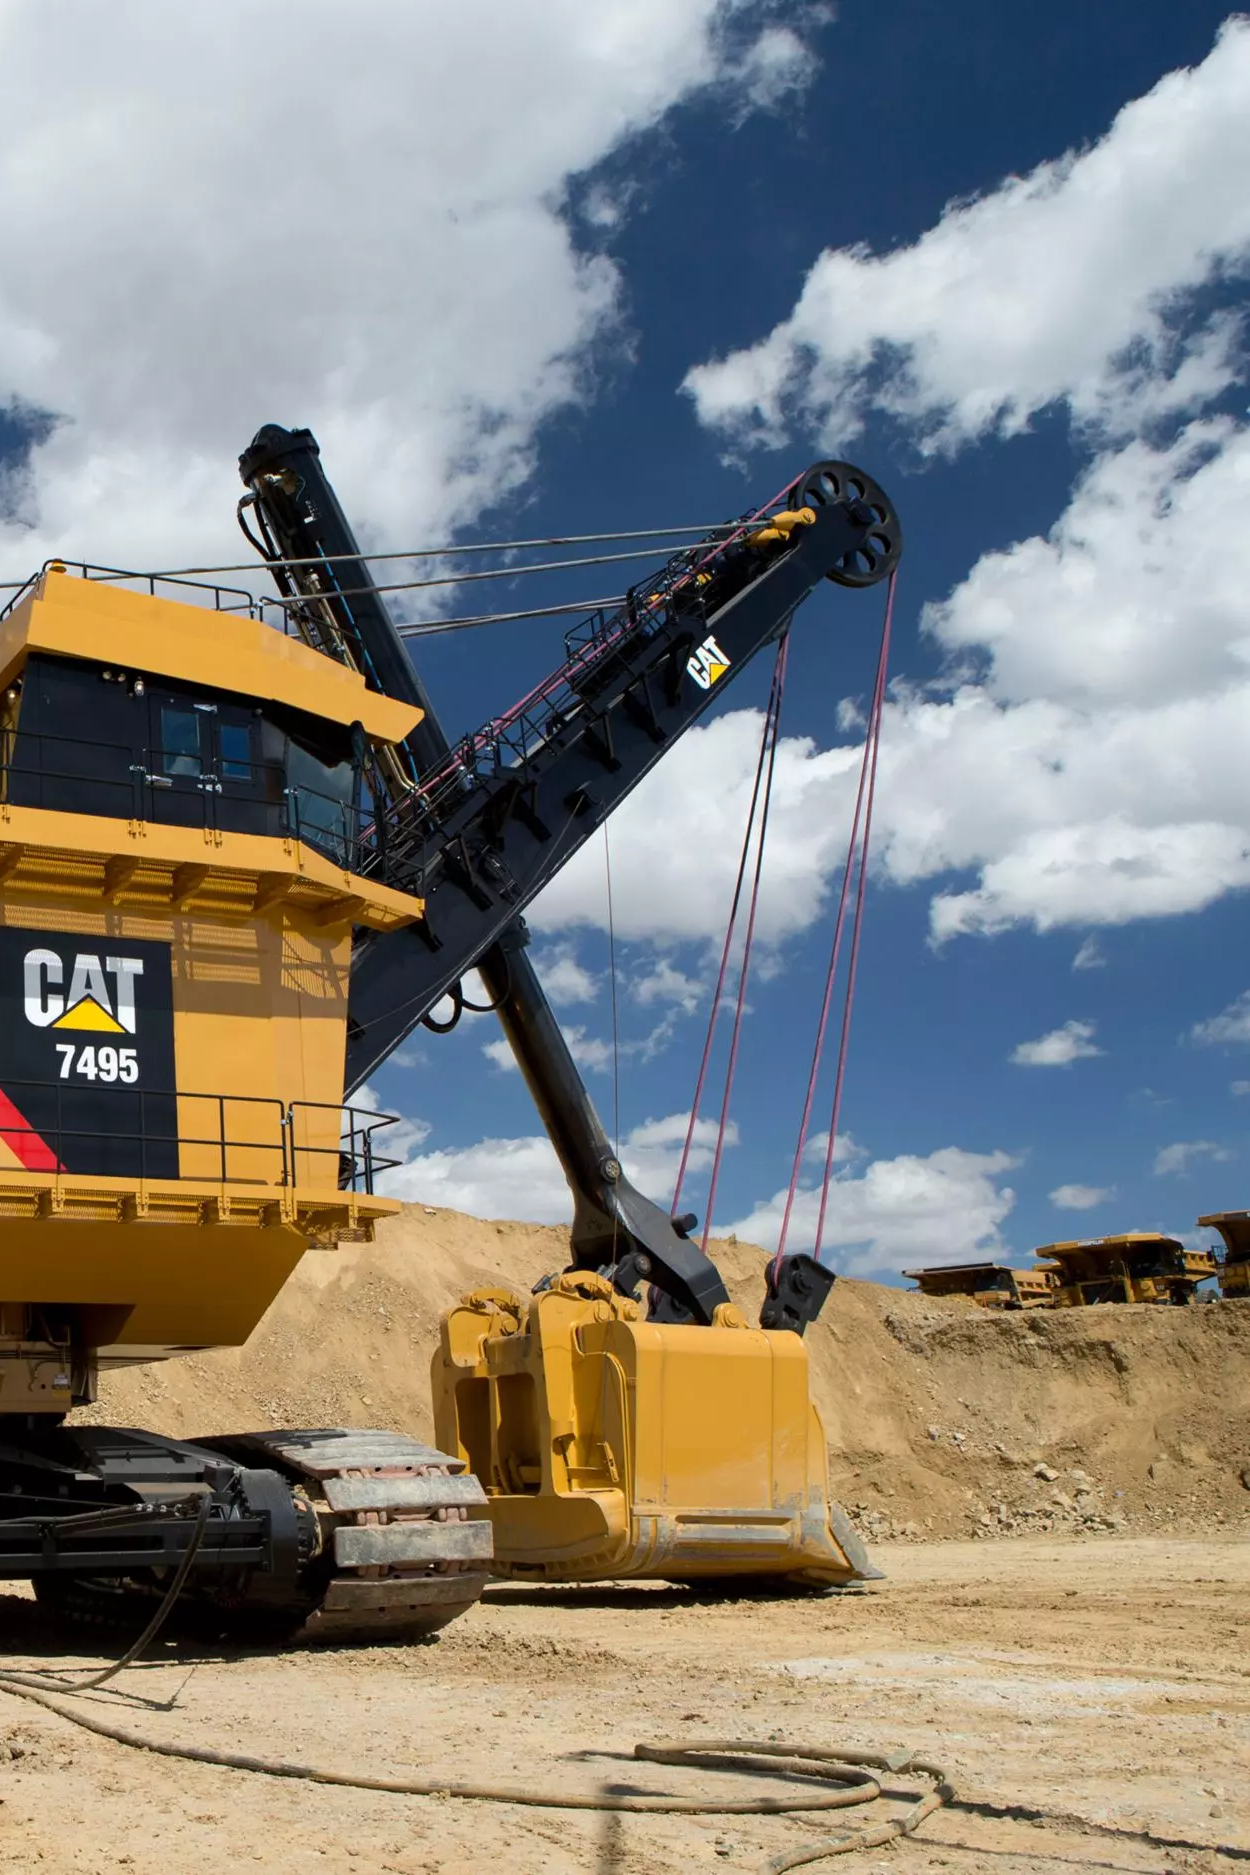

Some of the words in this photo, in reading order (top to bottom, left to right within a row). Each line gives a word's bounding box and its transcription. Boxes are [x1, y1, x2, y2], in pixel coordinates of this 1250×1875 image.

[686, 635, 731, 689] CAT
[24, 948, 144, 1034] CAT
[56, 1044, 139, 1083] 7495
